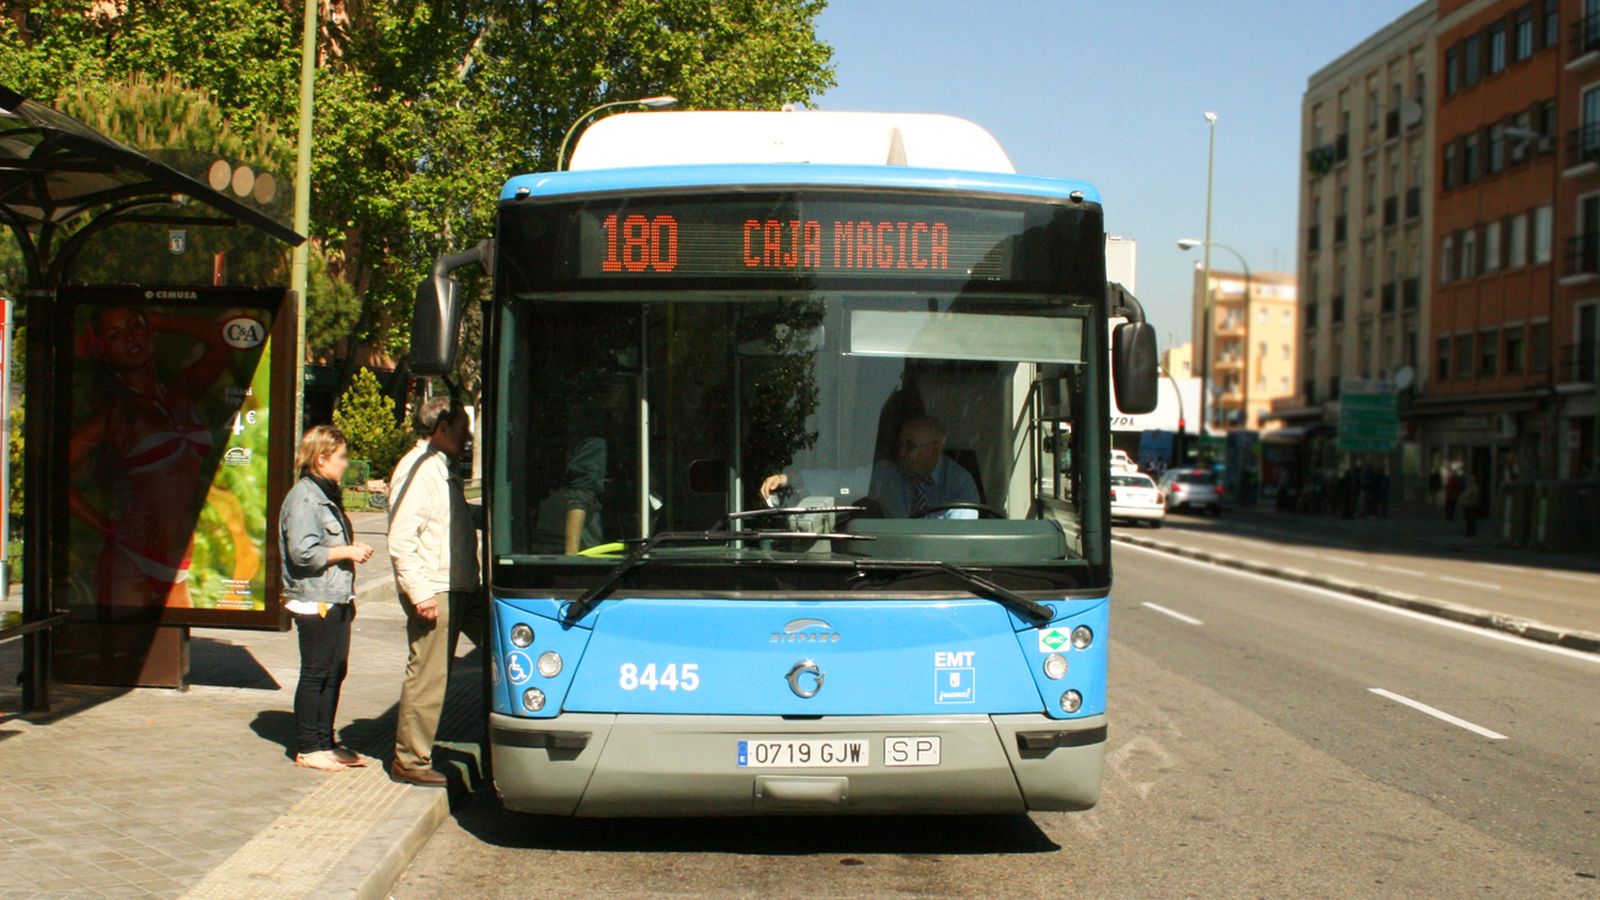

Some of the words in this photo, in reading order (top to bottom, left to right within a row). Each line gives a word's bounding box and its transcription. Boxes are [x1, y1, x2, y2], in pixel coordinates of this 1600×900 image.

[602, 214, 678, 272] 180
[743, 219, 821, 267] CAJA
[834, 221, 948, 269] MAGICA
[156, 291, 198, 299] CEMUSA
[227, 324, 259, 342] C&A
[1110, 416, 1135, 426] SOL
[934, 651, 976, 667] EMT
[619, 662, 700, 691] 8445
[755, 743, 811, 764] 0719
[820, 742, 862, 763] GJW
